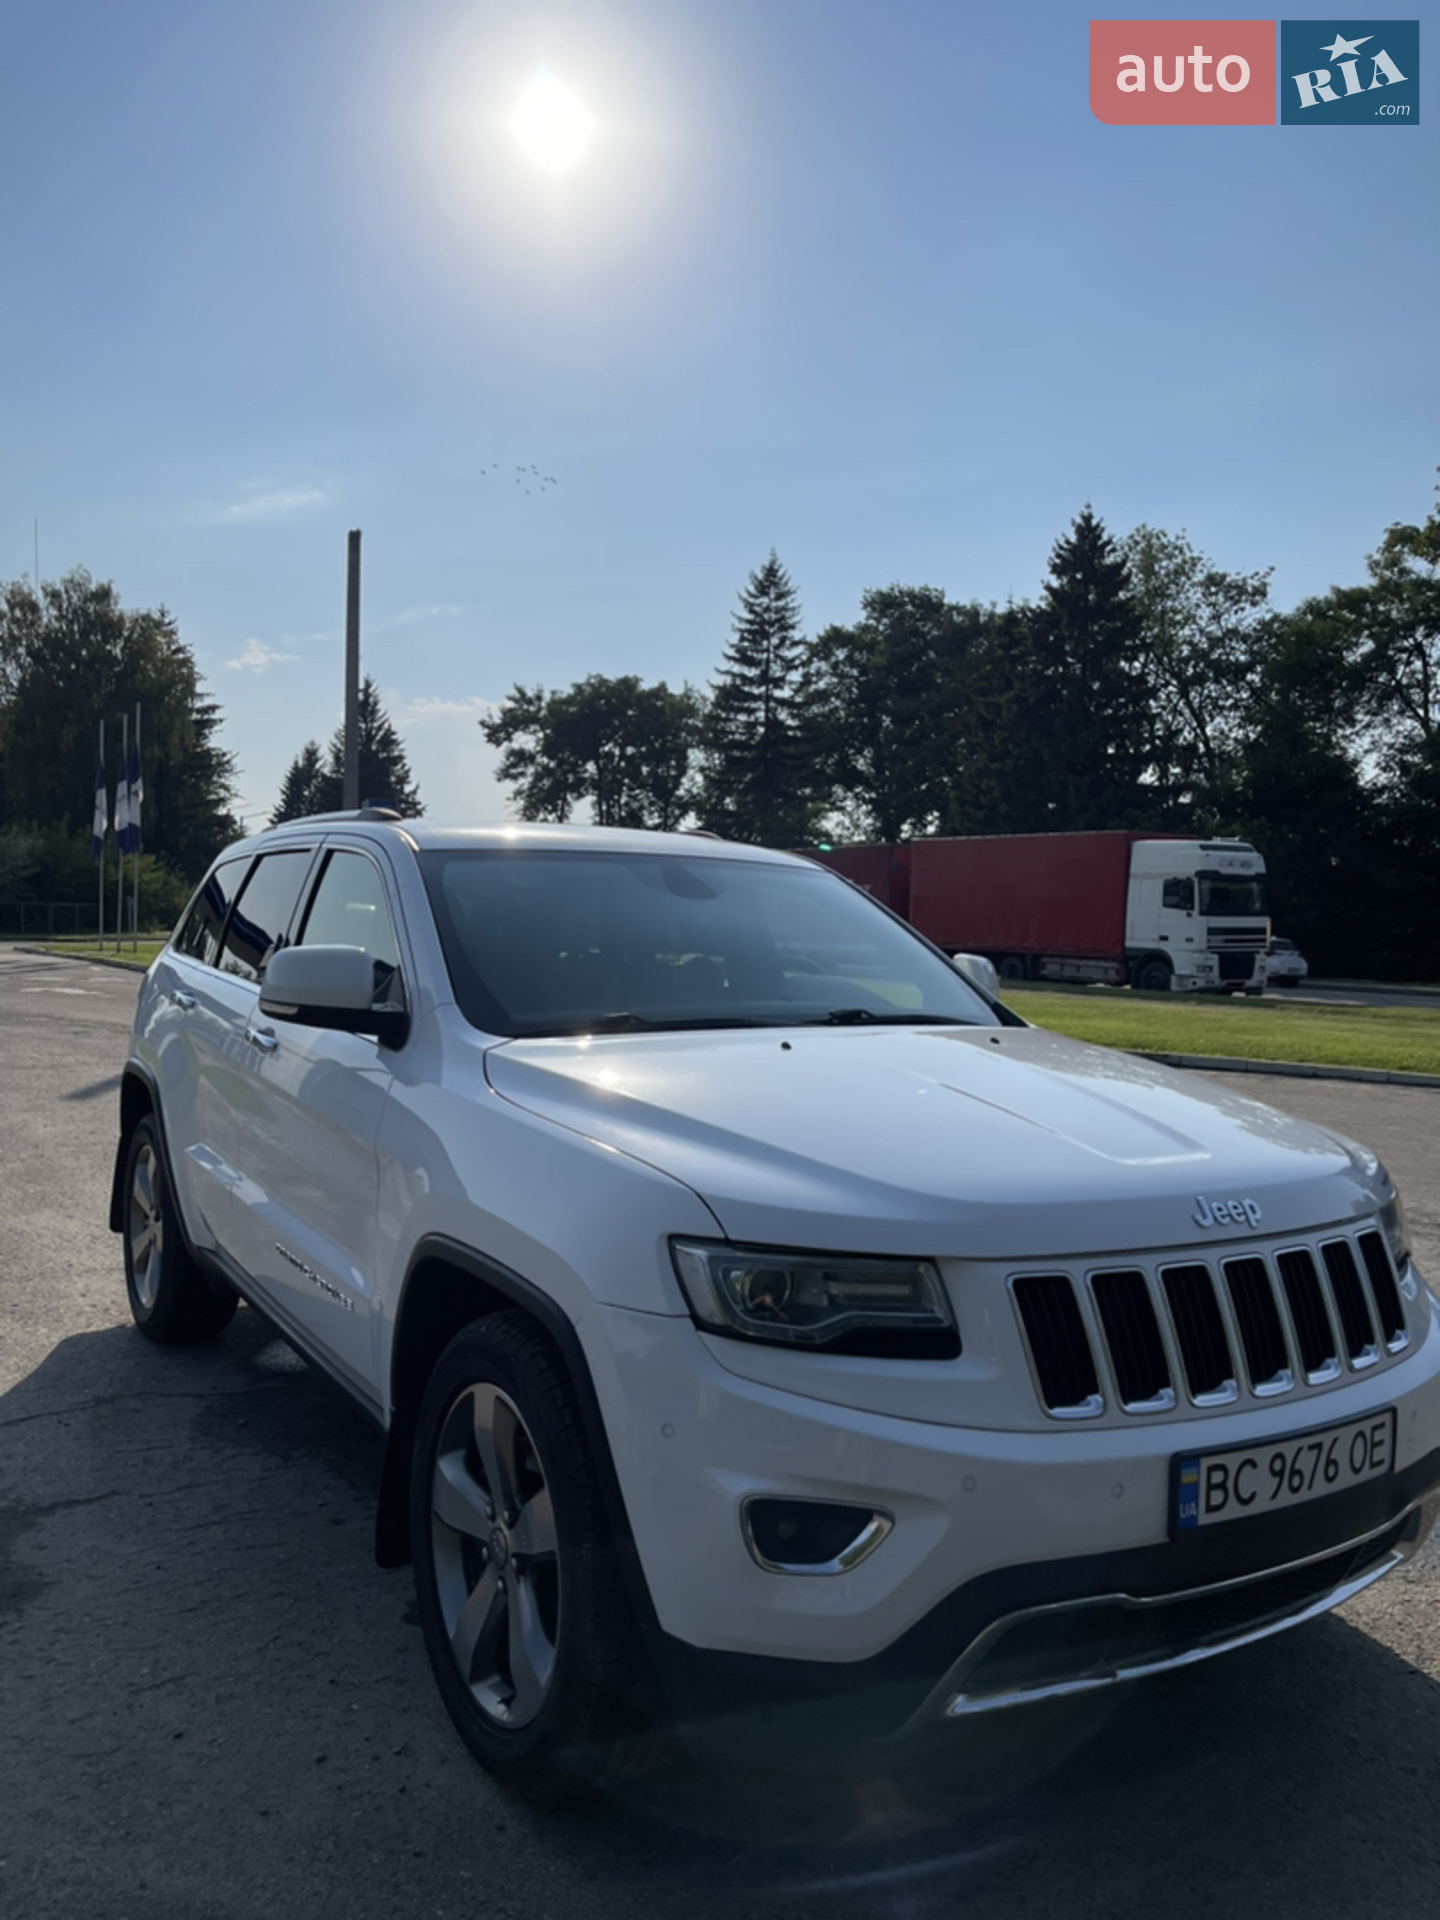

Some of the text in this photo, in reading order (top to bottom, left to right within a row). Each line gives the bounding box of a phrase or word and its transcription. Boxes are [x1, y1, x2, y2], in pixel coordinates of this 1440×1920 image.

[1192, 1195, 1262, 1228] Jeep
[1205, 1421, 1386, 1514] BC 9676 OE
[1179, 1501, 1198, 1519] UA
